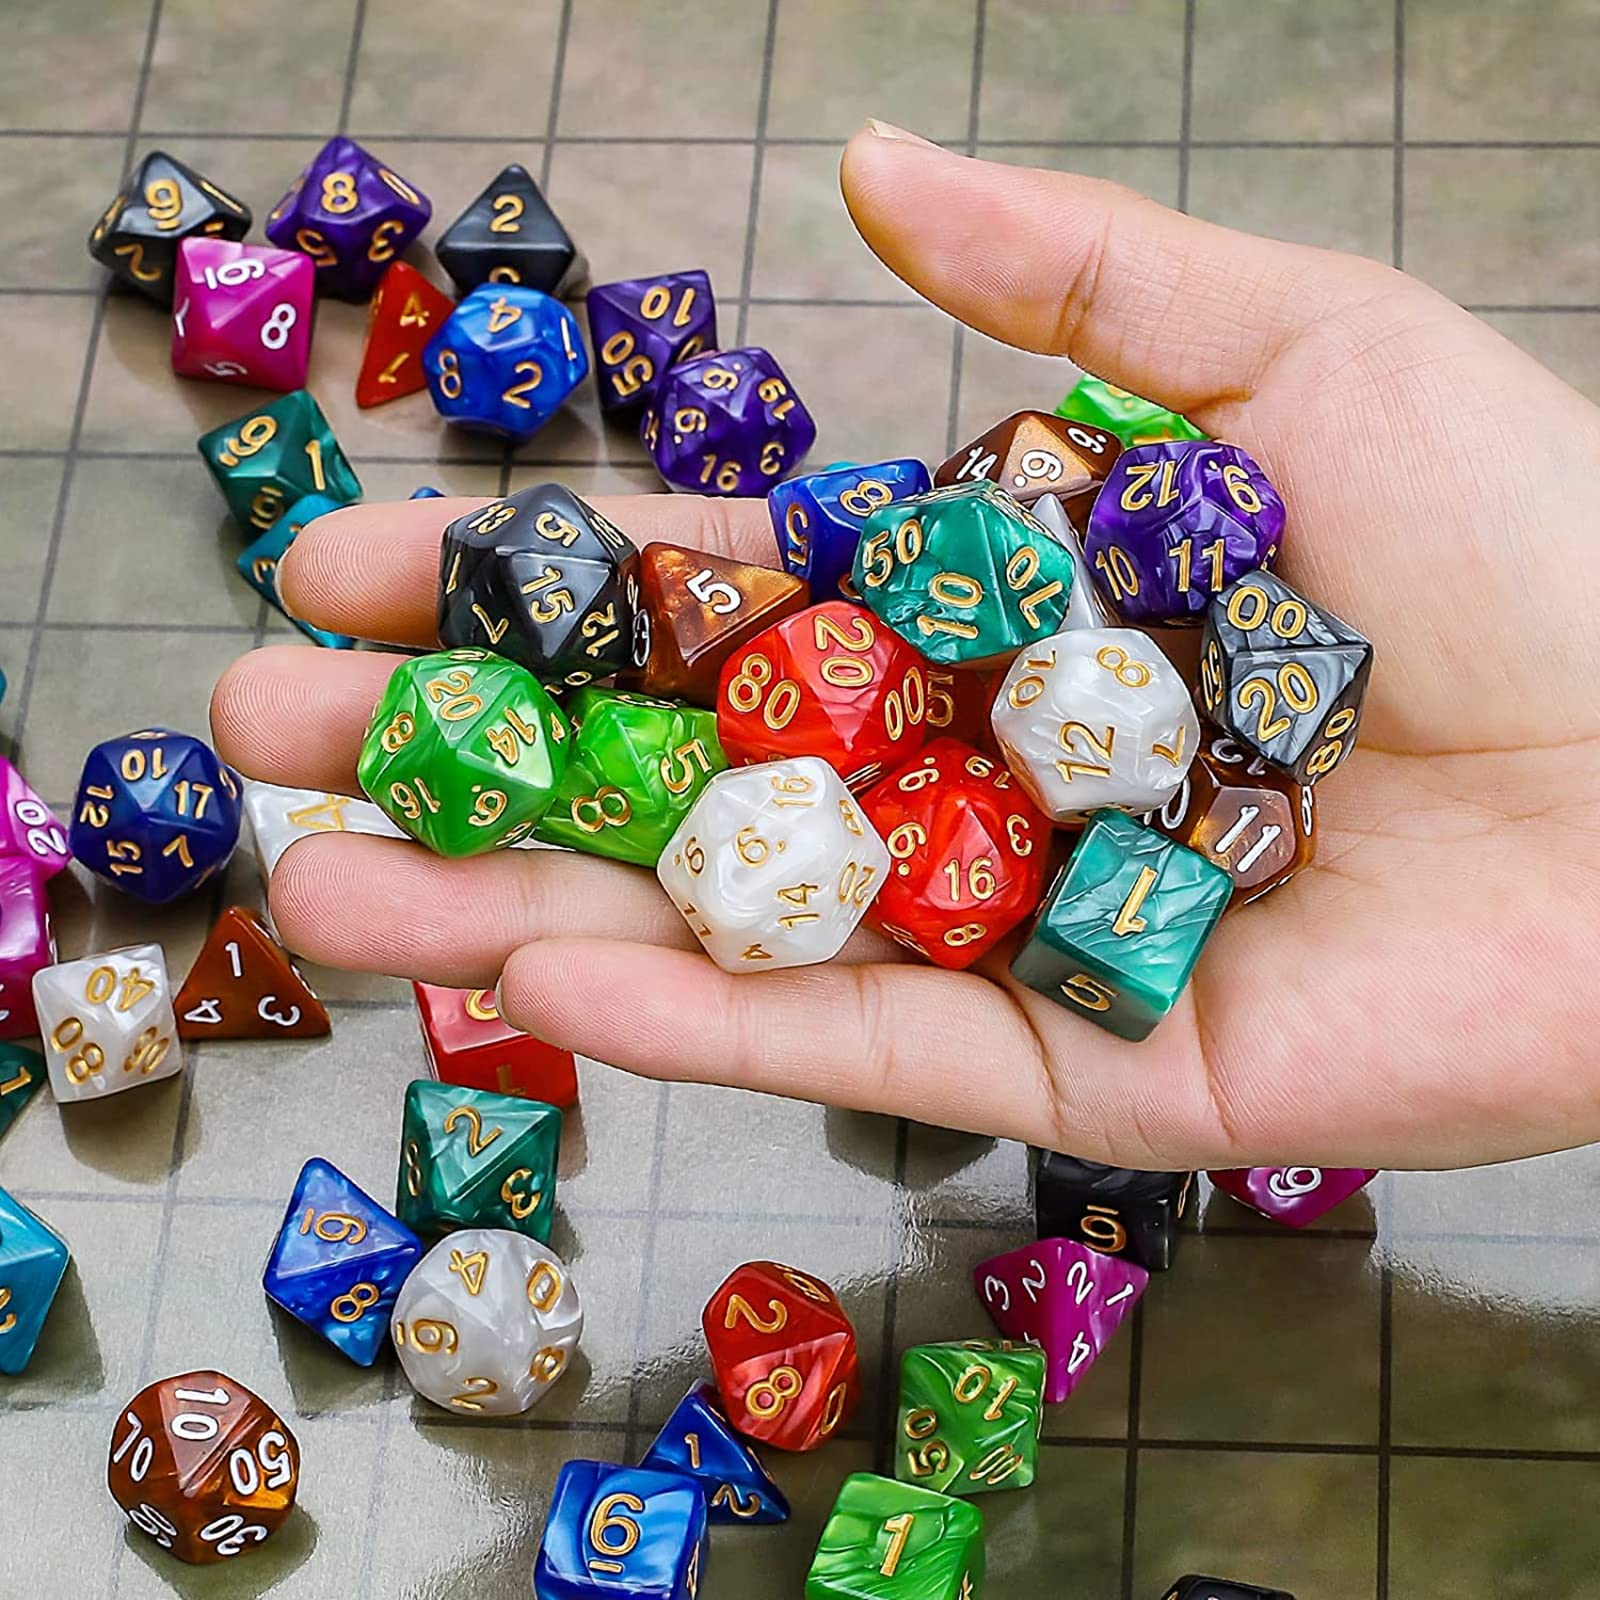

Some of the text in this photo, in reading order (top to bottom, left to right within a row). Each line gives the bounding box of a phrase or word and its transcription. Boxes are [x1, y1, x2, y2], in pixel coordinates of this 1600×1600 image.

[321, 172, 358, 214] 8
[490, 194, 525, 233] 2
[368, 220, 404, 263] 3
[261, 303, 297, 351] 8
[399, 294, 430, 328] 4
[487, 296, 522, 334] 4
[640, 286, 696, 328] 10
[438, 350, 462, 399] 8
[502, 361, 543, 409] 2
[601, 330, 654, 397] 50
[304, 440, 327, 491] 1
[700, 453, 743, 493] 16
[759, 441, 785, 476] 3
[955, 446, 998, 482] 14
[839, 479, 894, 518] 8
[1120, 460, 1181, 512] 12
[467, 504, 518, 535] 13
[535, 511, 581, 547] 5
[862, 518, 923, 588] 50
[1095, 545, 1140, 602] 10
[1168, 537, 1226, 594] 11
[521, 566, 574, 625] 15
[685, 568, 743, 614] 5
[915, 571, 984, 641] 10
[1006, 545, 1064, 631] 70
[1226, 584, 1308, 640] 00
[470, 602, 510, 645] 7
[582, 602, 620, 658] 12
[813, 614, 875, 688] 20
[1096, 645, 1152, 689] 8
[425, 671, 484, 722] 20
[728, 653, 801, 731] 80
[1008, 647, 1057, 710] 10
[1238, 661, 1320, 743] 20
[884, 666, 925, 741] 00
[381, 712, 416, 754] 8
[484, 707, 537, 766] 14
[1055, 720, 1116, 783] 12
[1151, 724, 1186, 768] 7
[1306, 707, 1356, 777] 80
[121, 748, 168, 781] 10
[660, 738, 714, 794] 5
[80, 785, 114, 828] 12
[173, 781, 213, 820] 17
[571, 785, 632, 834] 8
[15, 800, 67, 857] 20
[163, 835, 194, 868] 7
[1006, 814, 1033, 858] 3
[1215, 804, 1282, 874] 11
[106, 840, 143, 877] 15
[943, 856, 997, 903] 16
[777, 882, 821, 930] 14
[1111, 865, 1158, 937] 1
[944, 923, 987, 947] 8
[224, 941, 243, 979] 1
[85, 965, 155, 1013] 40
[184, 998, 223, 1024] 4
[258, 996, 301, 1028] 3
[1060, 973, 1120, 1012] 5
[50, 1015, 106, 1087] 80
[444, 1105, 505, 1159] 2
[502, 1167, 542, 1220] 3
[448, 1248, 490, 1297] 4
[526, 1259, 564, 1314] 0
[984, 1275, 1011, 1311] 3
[1021, 1259, 1047, 1303] 2
[1066, 1261, 1094, 1306] 2
[1106, 1283, 1136, 1307] 1
[330, 1282, 380, 1323] 8
[724, 1294, 788, 1334] 2
[1066, 1332, 1092, 1375] 4
[170, 1388, 230, 1441] 10
[449, 1376, 498, 1411] 2
[745, 1366, 804, 1421] 8
[820, 1382, 848, 1436] 0
[954, 1365, 1019, 1422] 10
[113, 1412, 154, 1483] 70
[229, 1430, 292, 1497] 50
[683, 1433, 701, 1469] 1
[905, 1406, 949, 1477] 50
[711, 1483, 761, 1518] 2
[199, 1514, 268, 1556] 30
[588, 1492, 645, 1574] 6
[879, 1513, 915, 1578] 1
